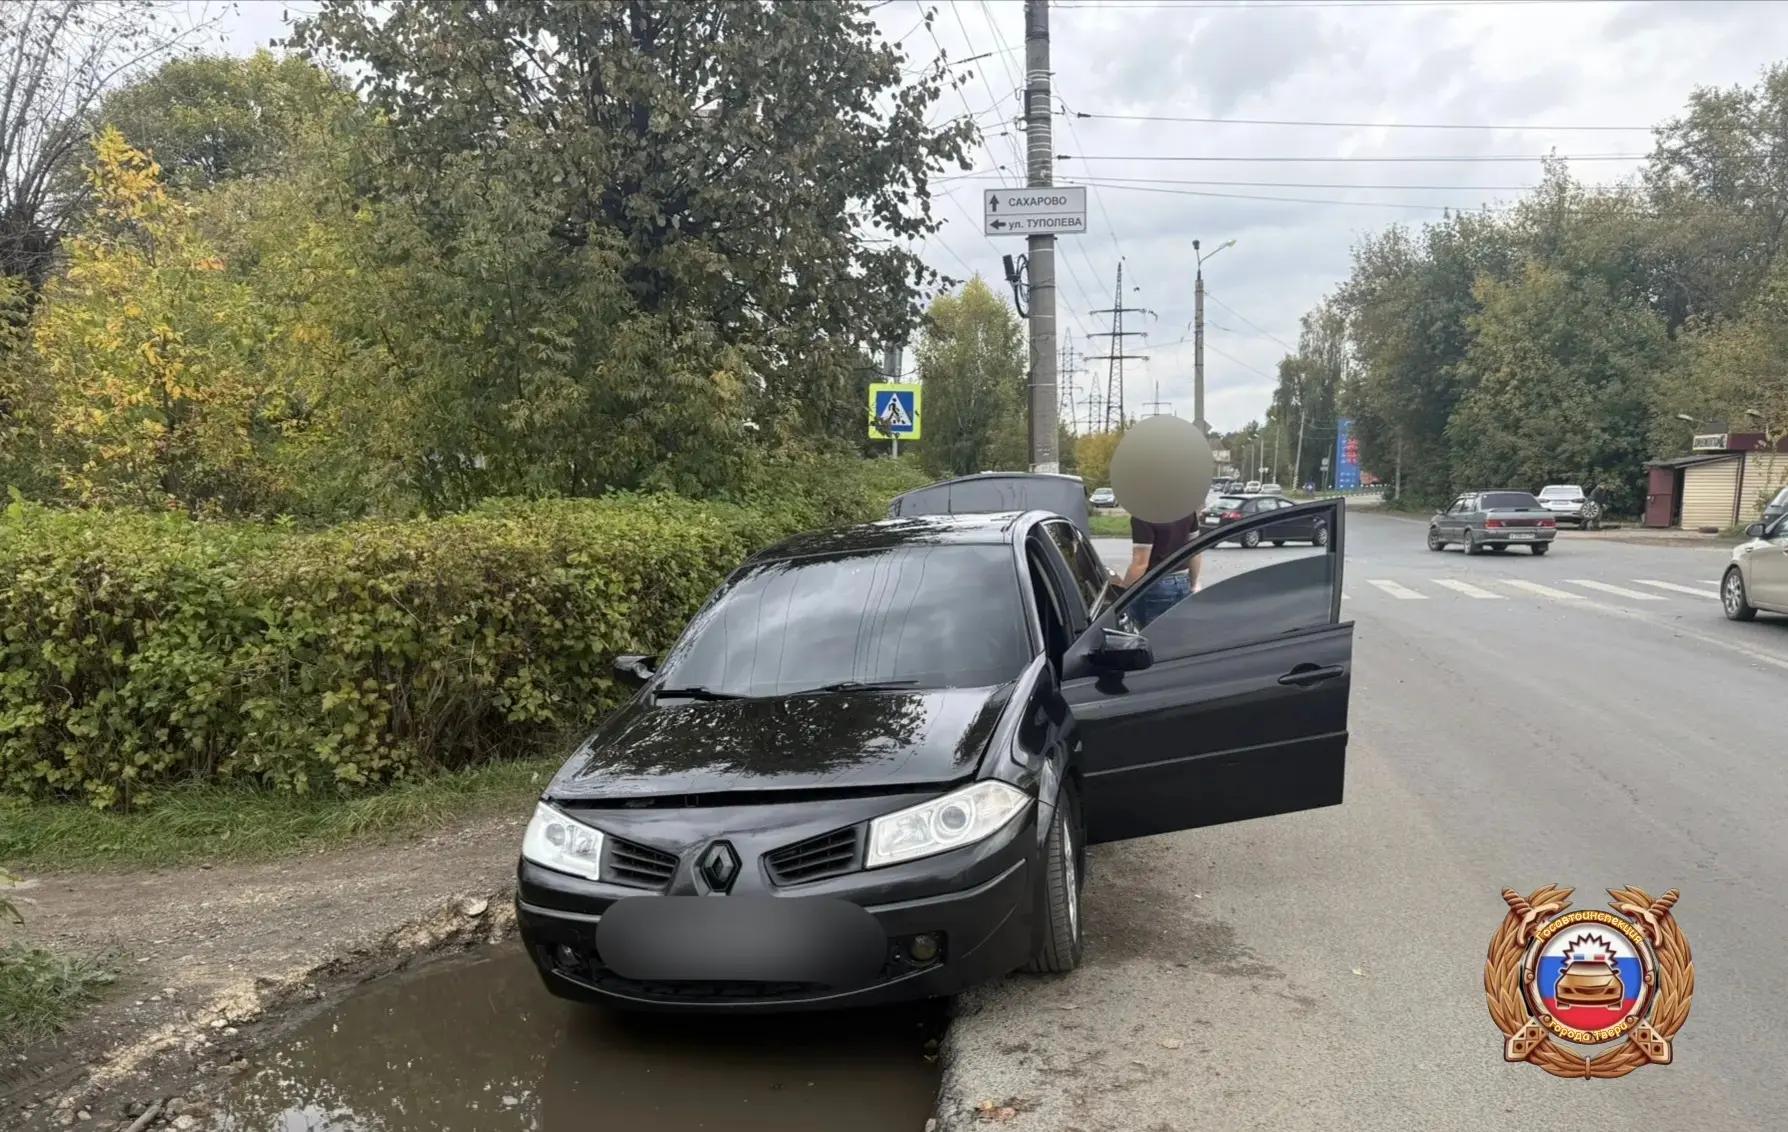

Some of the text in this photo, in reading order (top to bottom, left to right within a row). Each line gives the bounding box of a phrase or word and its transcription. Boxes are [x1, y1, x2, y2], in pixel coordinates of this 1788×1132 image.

[1008, 196, 1067, 207] САХАРОВО
[1008, 217, 1082, 231] ул. ТУПОЛЕВА
